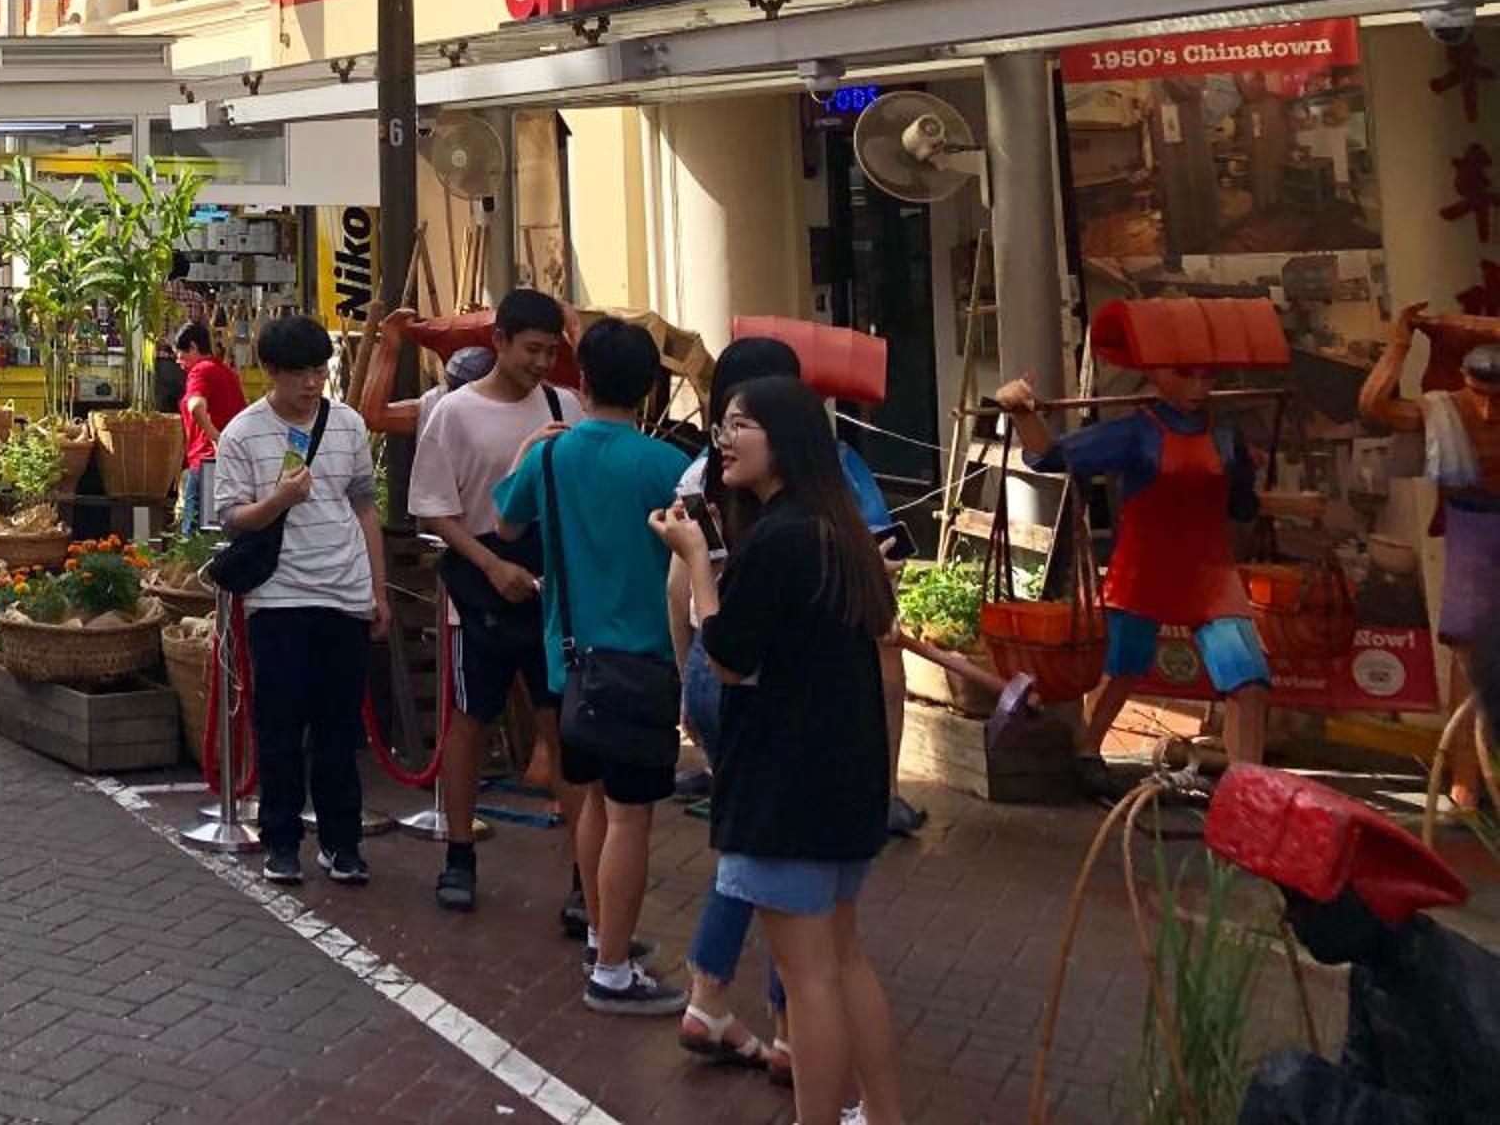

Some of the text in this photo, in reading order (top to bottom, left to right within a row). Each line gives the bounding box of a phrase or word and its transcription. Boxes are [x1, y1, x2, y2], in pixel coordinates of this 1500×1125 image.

[1091, 36, 1333, 70] 1950's Chinatown
[389, 118, 404, 146] 6
